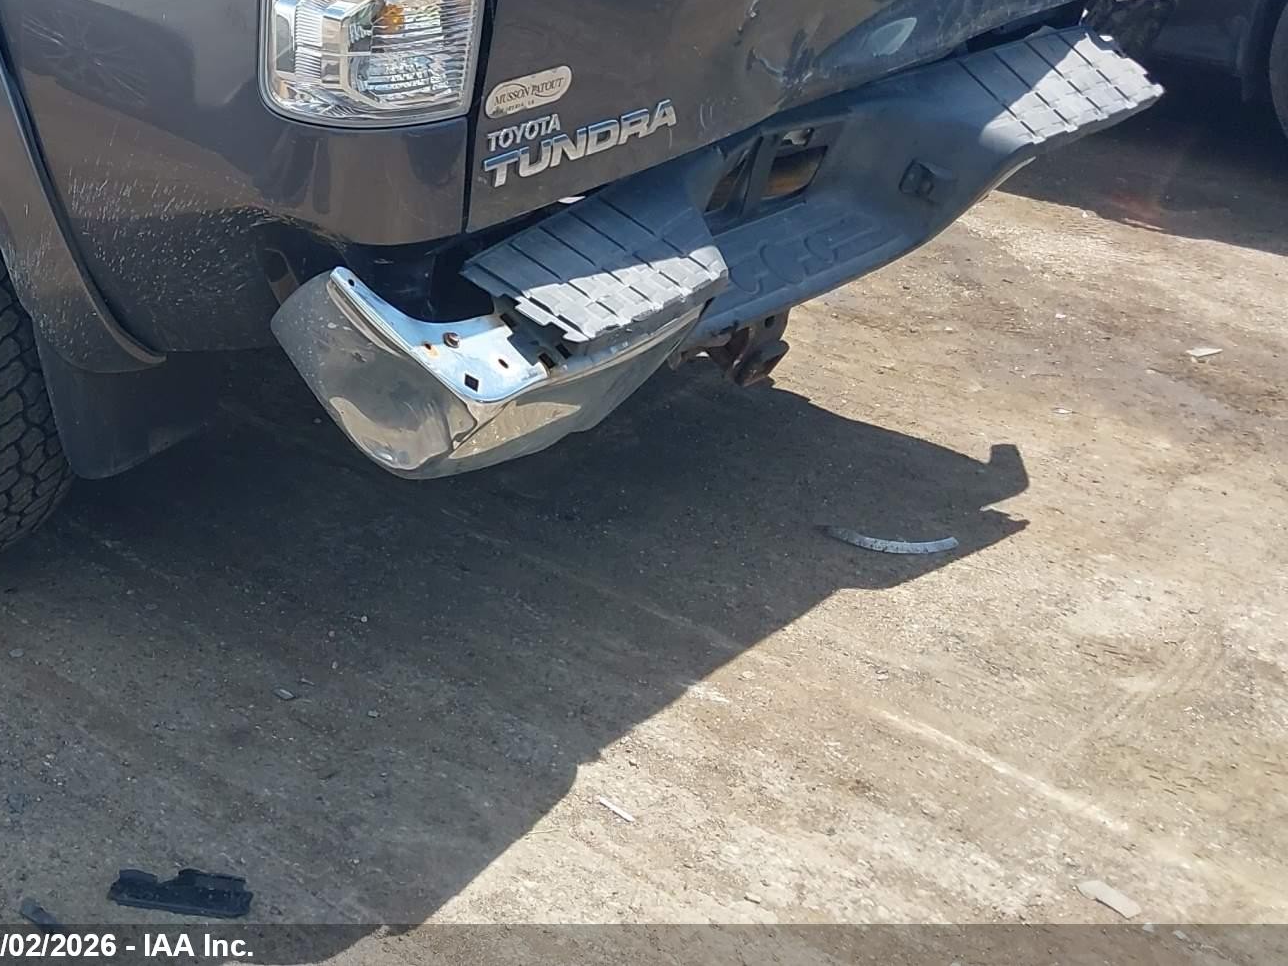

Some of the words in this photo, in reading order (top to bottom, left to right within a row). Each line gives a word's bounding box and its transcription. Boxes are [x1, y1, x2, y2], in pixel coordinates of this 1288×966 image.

[494, 86, 530, 107] MUSSON
[531, 77, 564, 96] PATOUT
[483, 98, 677, 188] TUNDRA
[487, 113, 561, 152] TOYOTA
